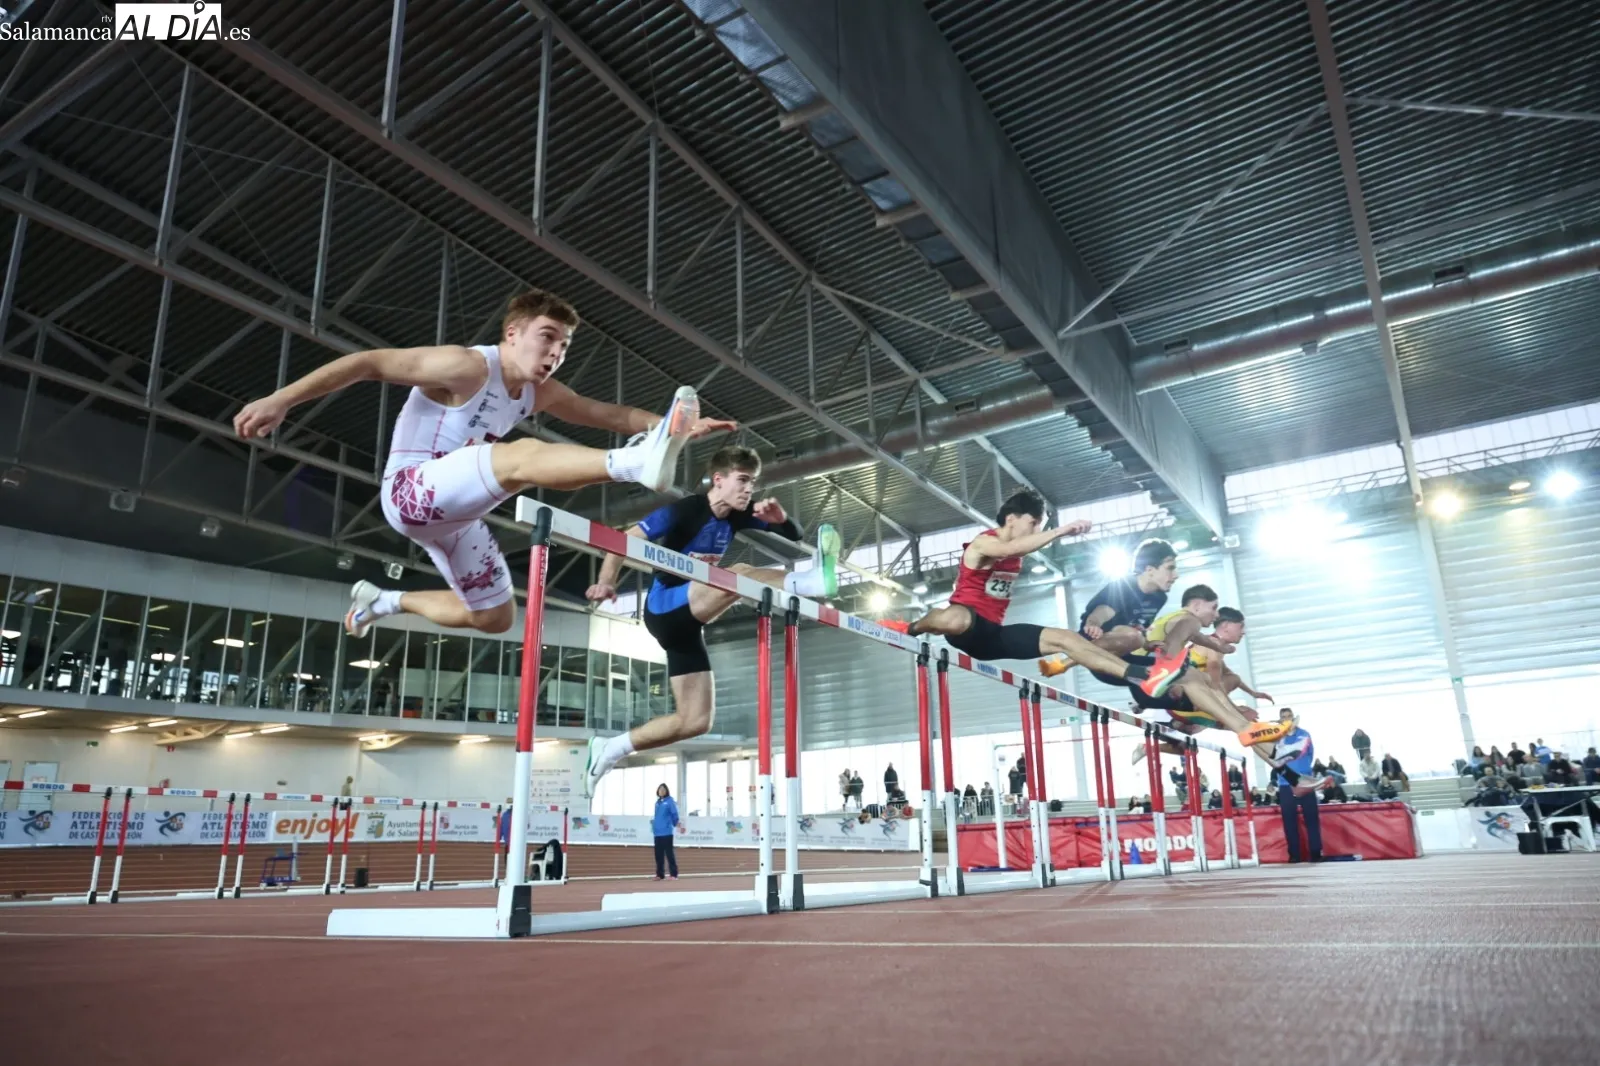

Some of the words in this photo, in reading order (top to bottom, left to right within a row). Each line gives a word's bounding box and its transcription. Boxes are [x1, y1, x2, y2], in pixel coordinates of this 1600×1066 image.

[643, 543, 695, 575] MONDO
[135, 812, 146, 820] DE
[201, 821, 268, 830] ATLTISMO
[275, 812, 360, 840] enjoy!
